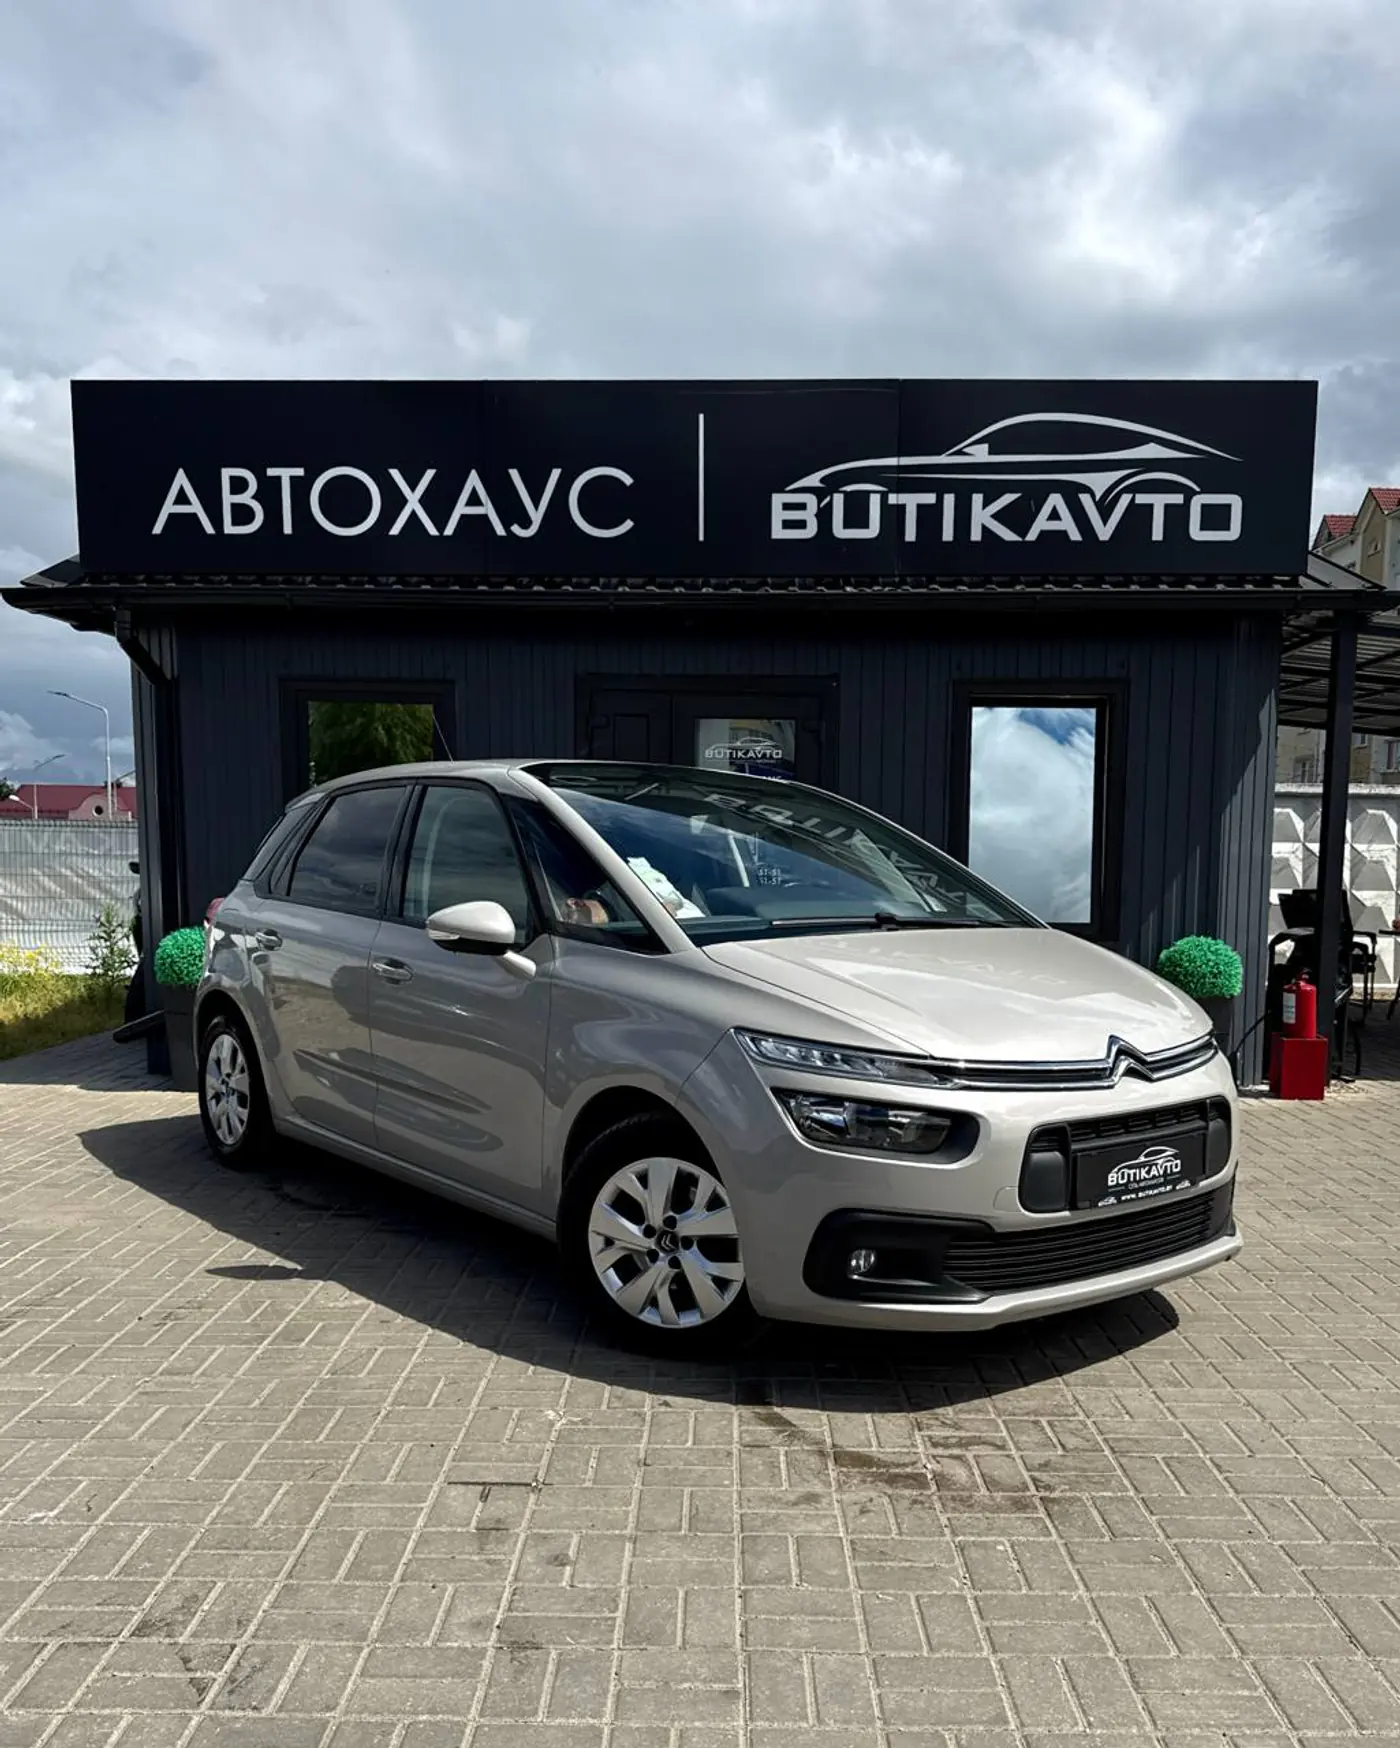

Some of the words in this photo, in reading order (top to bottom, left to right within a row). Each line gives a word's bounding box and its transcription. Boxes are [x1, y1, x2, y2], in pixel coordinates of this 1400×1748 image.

[151, 465, 635, 538] АВТОХАУС
[770, 492, 1243, 541] BUTIKAVTO
[704, 749, 783, 758] BUTIKAVTO
[1107, 1160, 1182, 1186] BUTIKAVTO
